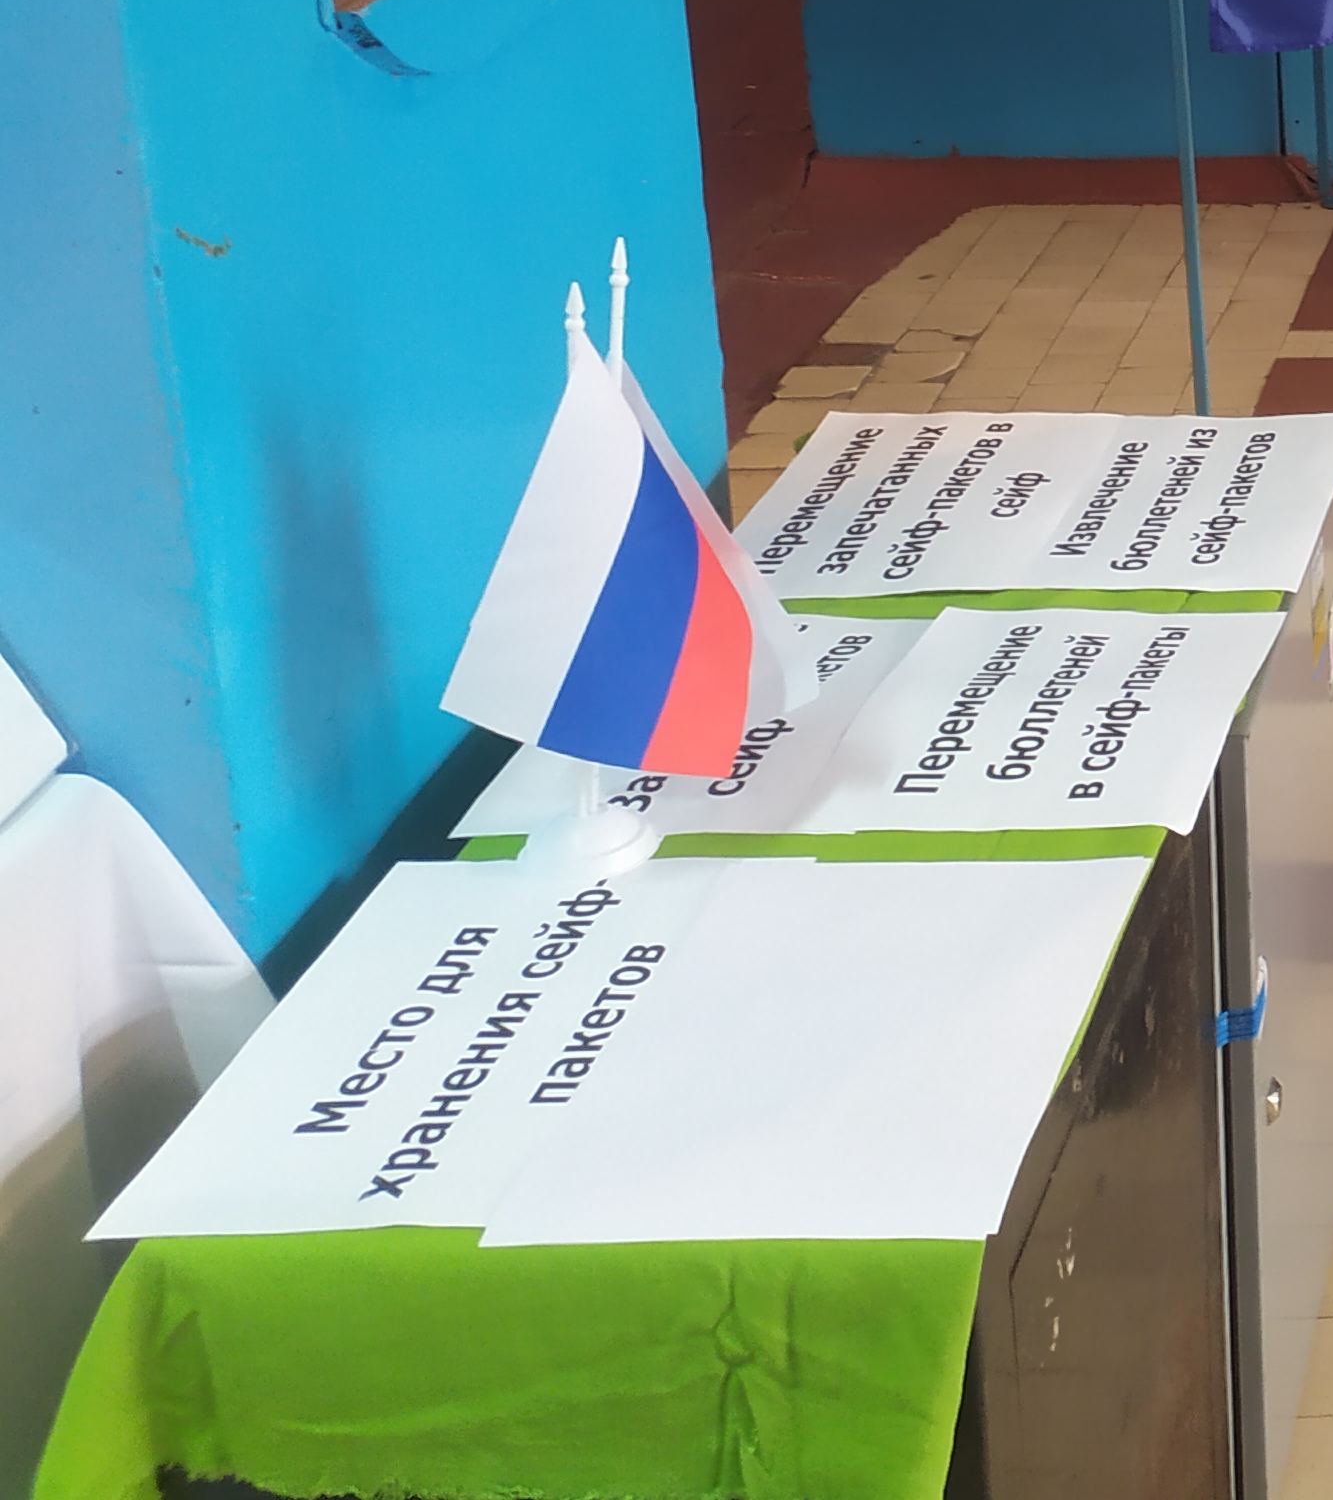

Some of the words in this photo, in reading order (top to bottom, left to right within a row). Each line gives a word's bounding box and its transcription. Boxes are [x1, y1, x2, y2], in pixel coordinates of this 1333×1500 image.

[817, 425, 948, 574] запечатанных
[883, 437, 1004, 580] сейф-пакетов
[985, 422, 1014, 433] в
[990, 471, 1051, 518] сейф
[1049, 441, 1149, 556] Извлечение
[1110, 454, 1206, 571] бюллетеней
[1186, 428, 1218, 448] из
[1190, 432, 1276, 565] сейф-пакетов
[894, 625, 1042, 793] Перемещение
[986, 634, 1110, 781] бюллетеней
[1081, 626, 1190, 771] сейф-пакеты
[293, 1006, 435, 1134] Место
[416, 927, 498, 994] для
[357, 992, 541, 1202] хранения
[529, 944, 666, 1104] пакетов
